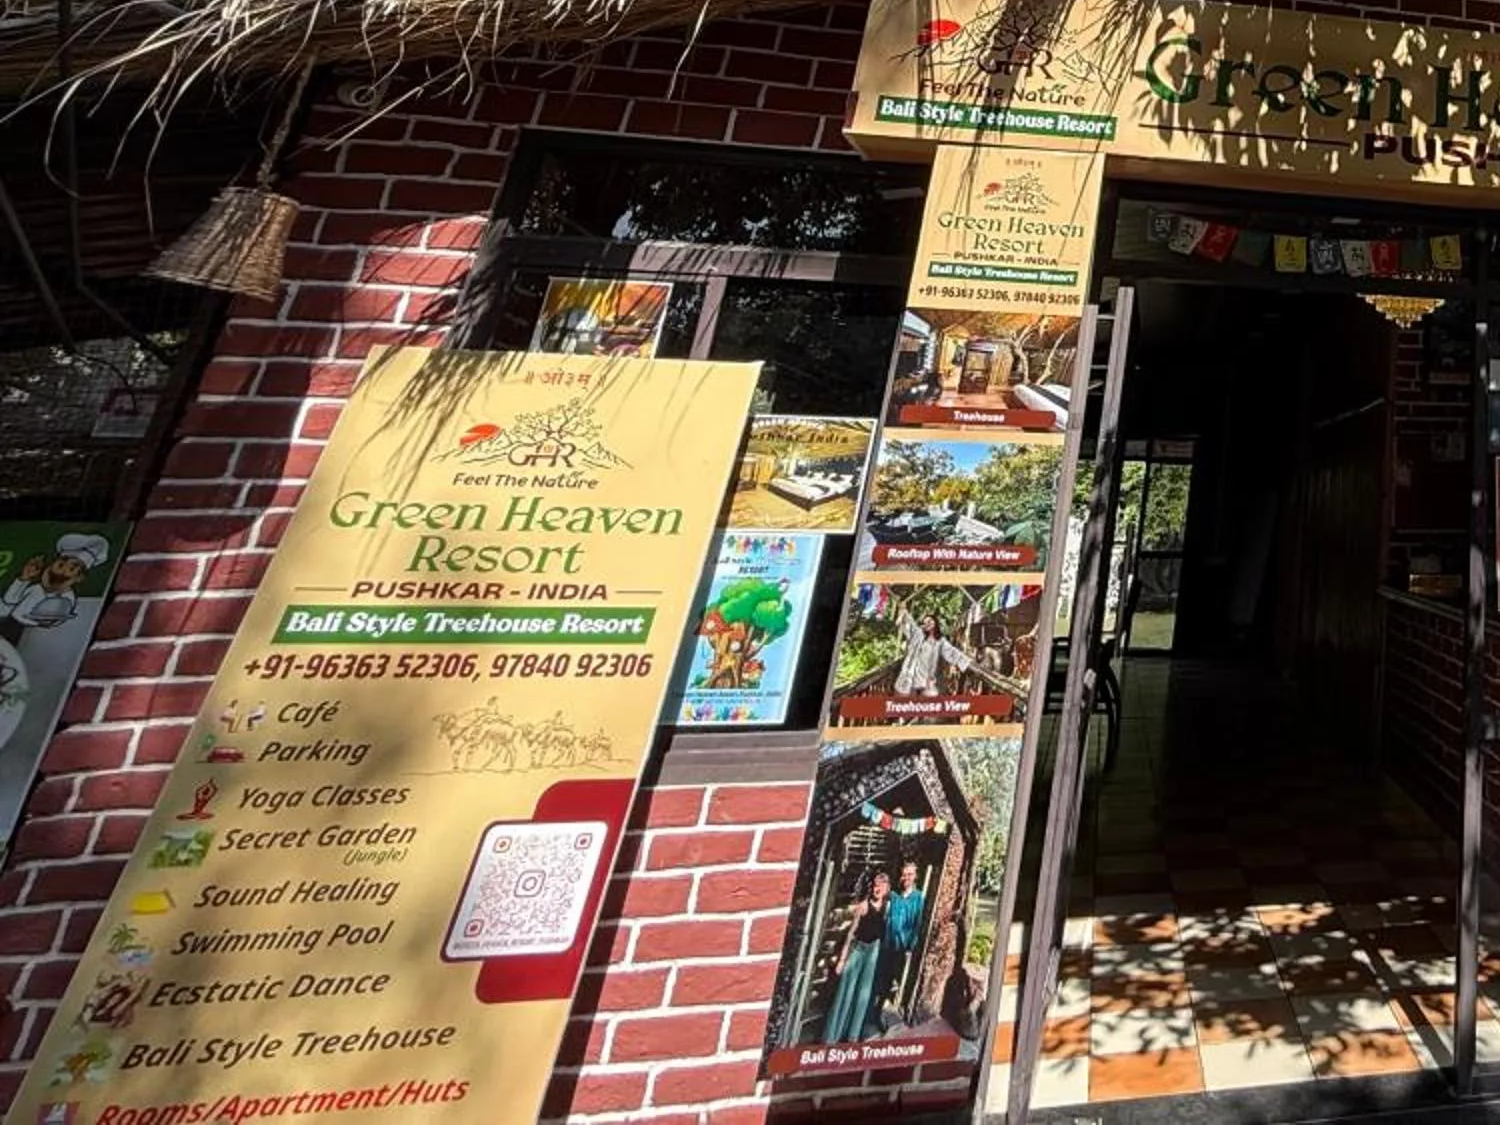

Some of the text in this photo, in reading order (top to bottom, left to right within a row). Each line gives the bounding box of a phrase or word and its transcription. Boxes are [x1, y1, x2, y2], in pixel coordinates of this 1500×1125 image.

[920, 78, 1086, 108] Feel The Nature
[1145, 32, 1410, 126] Green
[881, 98, 1114, 136] Bali Style Treehouse Resort
[937, 212, 1085, 238] Green Heaven
[972, 232, 1045, 254] Resort
[953, 411, 1005, 424] Treehouse
[453, 471, 599, 490] Feel The Nature
[329, 491, 684, 535] Green Heaven
[404, 536, 584, 575] Resort
[887, 548, 1020, 562] Rooftop With Nature View
[350, 582, 608, 602] PUSHKAR INDIA
[285, 612, 645, 637] Bali Style Treehouse Resort
[244, 654, 654, 681] +91-96363 52306, 97840 92306
[277, 700, 341, 725] Café
[885, 699, 971, 713] Treehouse View
[257, 739, 371, 769] Parking
[237, 784, 411, 812] Yoga Classes
[218, 822, 418, 852] Secret Garden
[194, 878, 399, 909] Sound Healing
[171, 920, 395, 958] Swimming Pool
[148, 972, 391, 1009] Ecstatic Dance
[120, 1024, 457, 1070] Bali Style Treehouse
[801, 1044, 923, 1065] Bali Style Treehouse
